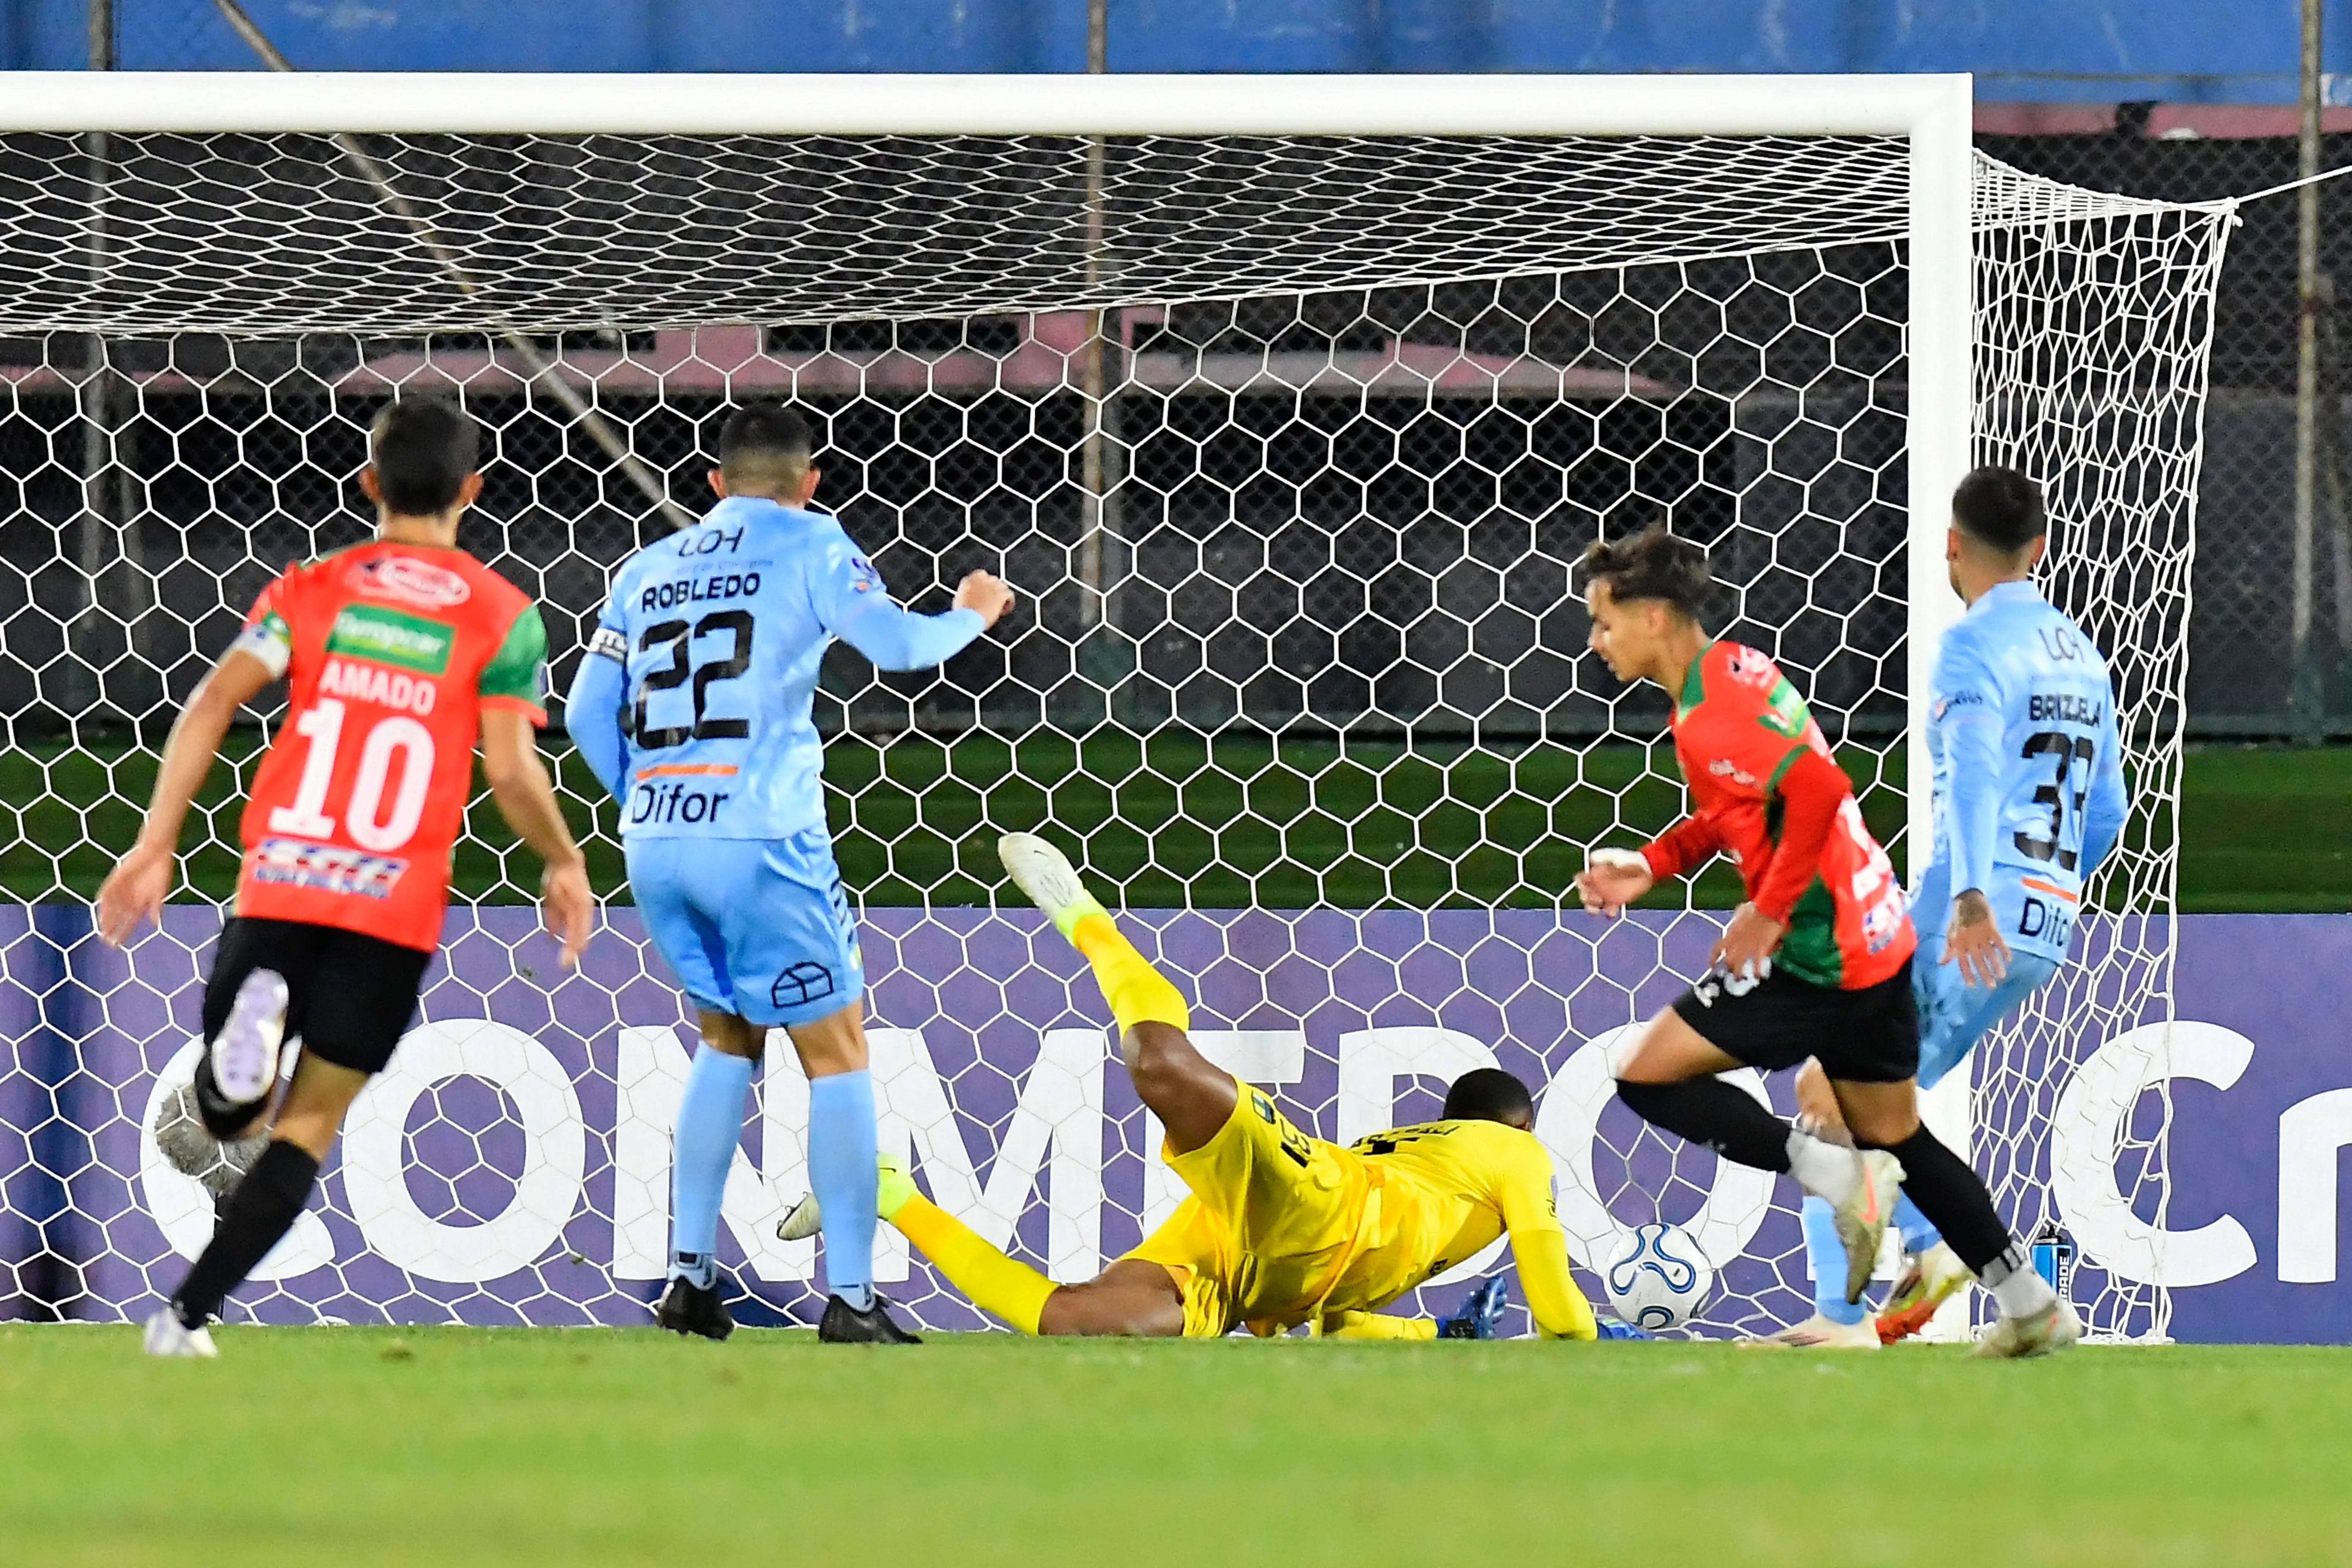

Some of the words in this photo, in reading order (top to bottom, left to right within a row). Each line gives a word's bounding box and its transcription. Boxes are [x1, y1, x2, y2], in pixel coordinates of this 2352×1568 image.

[642, 572, 760, 613] ROBLEDO
[319, 660, 437, 716] AMADO
[635, 609, 754, 750] 22
[267, 696, 436, 853] 10
[631, 782, 729, 823] Difor
